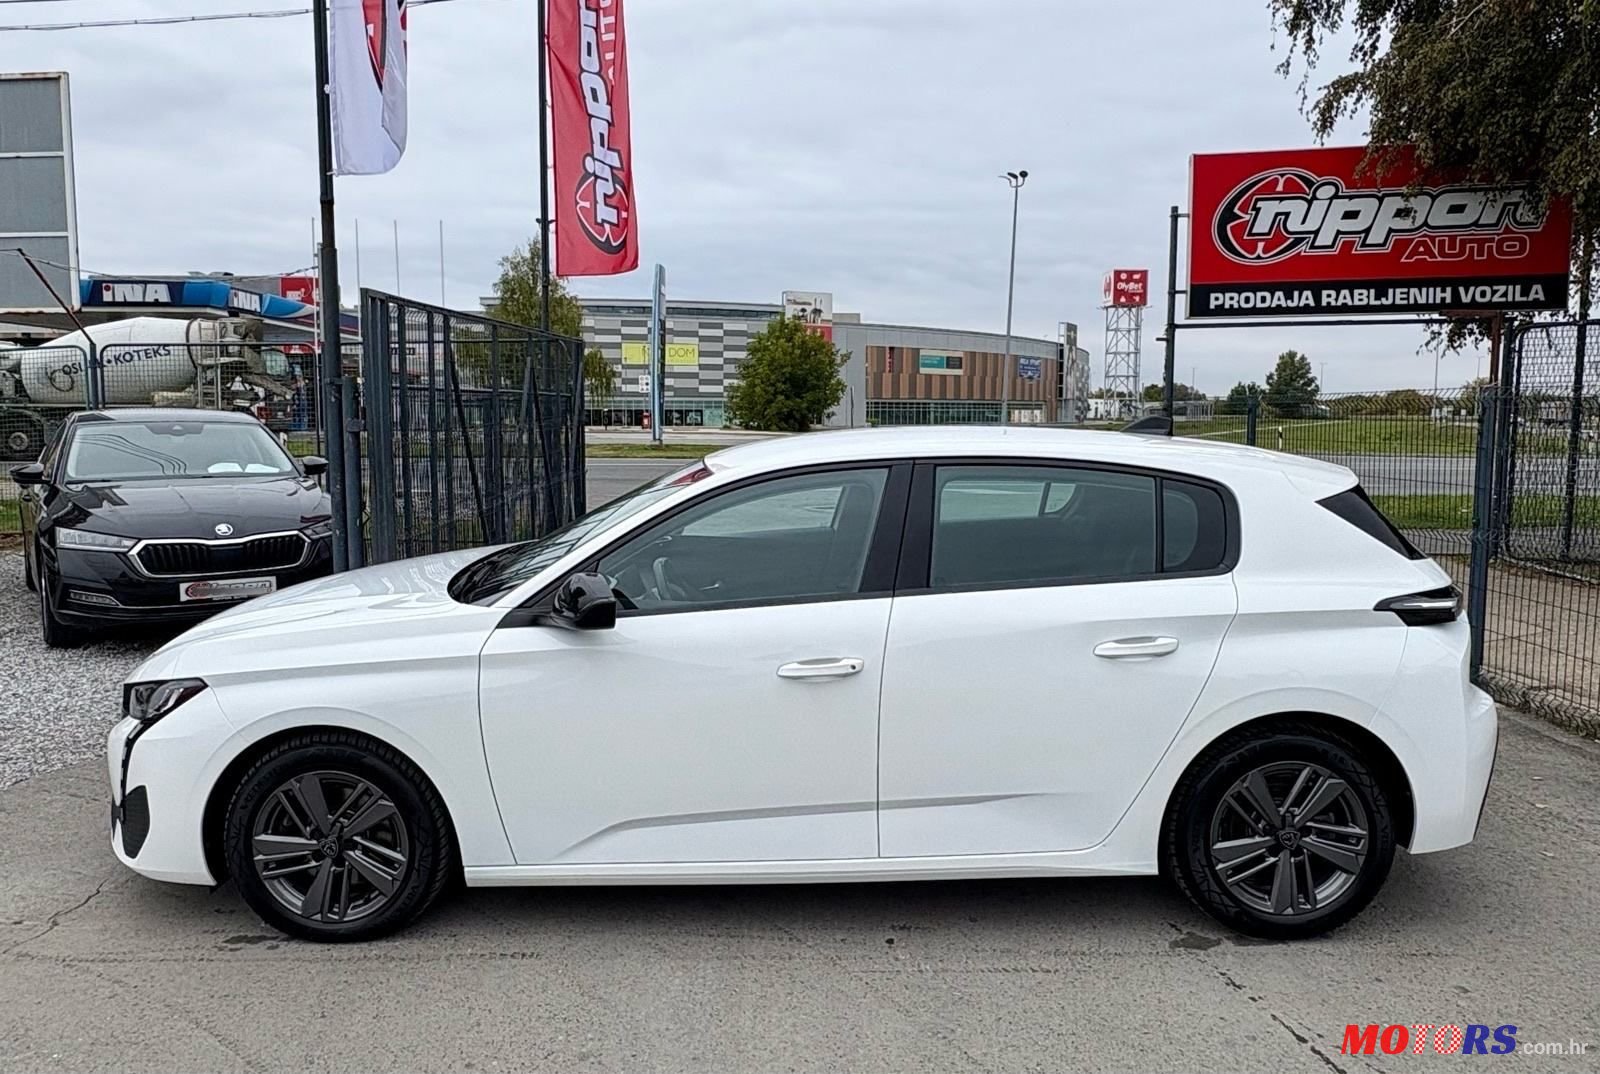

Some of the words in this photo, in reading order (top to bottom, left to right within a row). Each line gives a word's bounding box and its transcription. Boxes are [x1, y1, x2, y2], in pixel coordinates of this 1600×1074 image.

[1401, 234, 1529, 262] AUTO
[1209, 288, 1315, 309] PRODAJA
[1321, 286, 1452, 307] RABLJENIH
[1459, 283, 1545, 304] VOZILA
